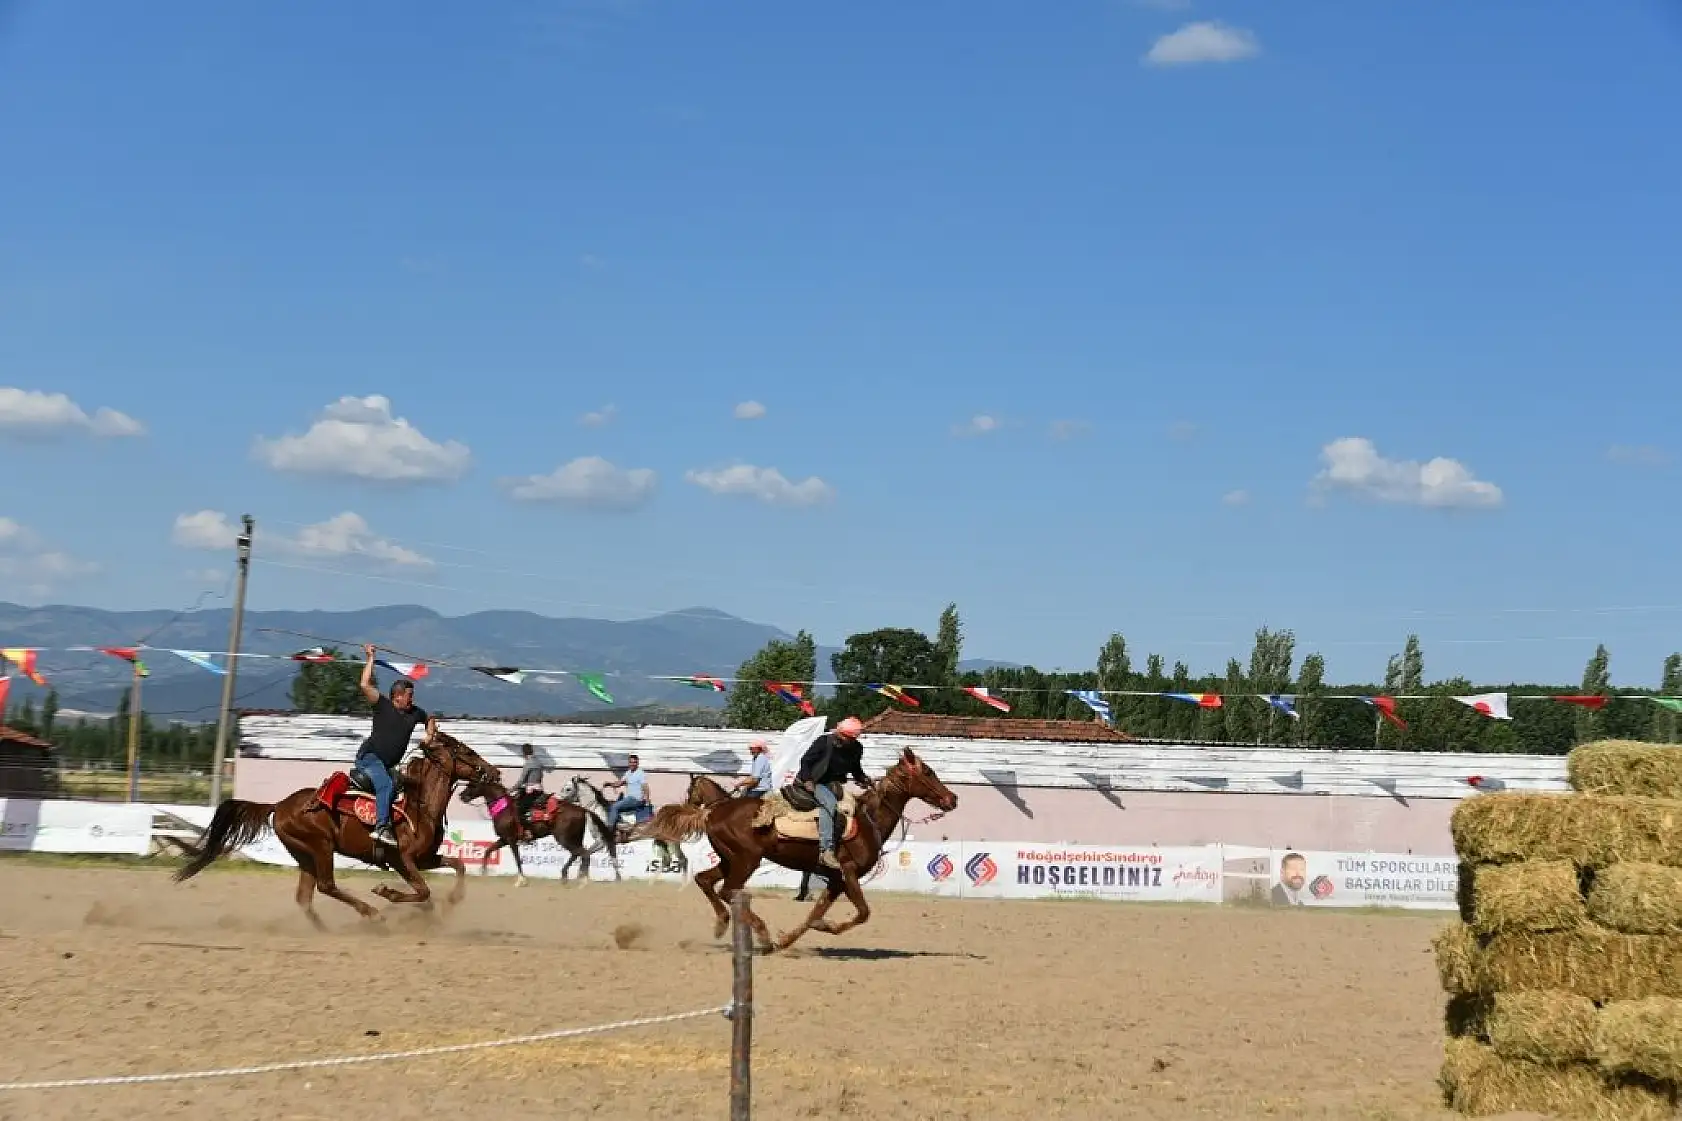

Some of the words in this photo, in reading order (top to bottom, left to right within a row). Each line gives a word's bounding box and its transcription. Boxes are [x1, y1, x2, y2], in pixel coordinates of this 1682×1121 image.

[1336, 857, 1366, 872] TÜM
[1016, 863, 1163, 889] HOŞGELDİNİZ
[1344, 876, 1421, 892] BAŞARILAR
